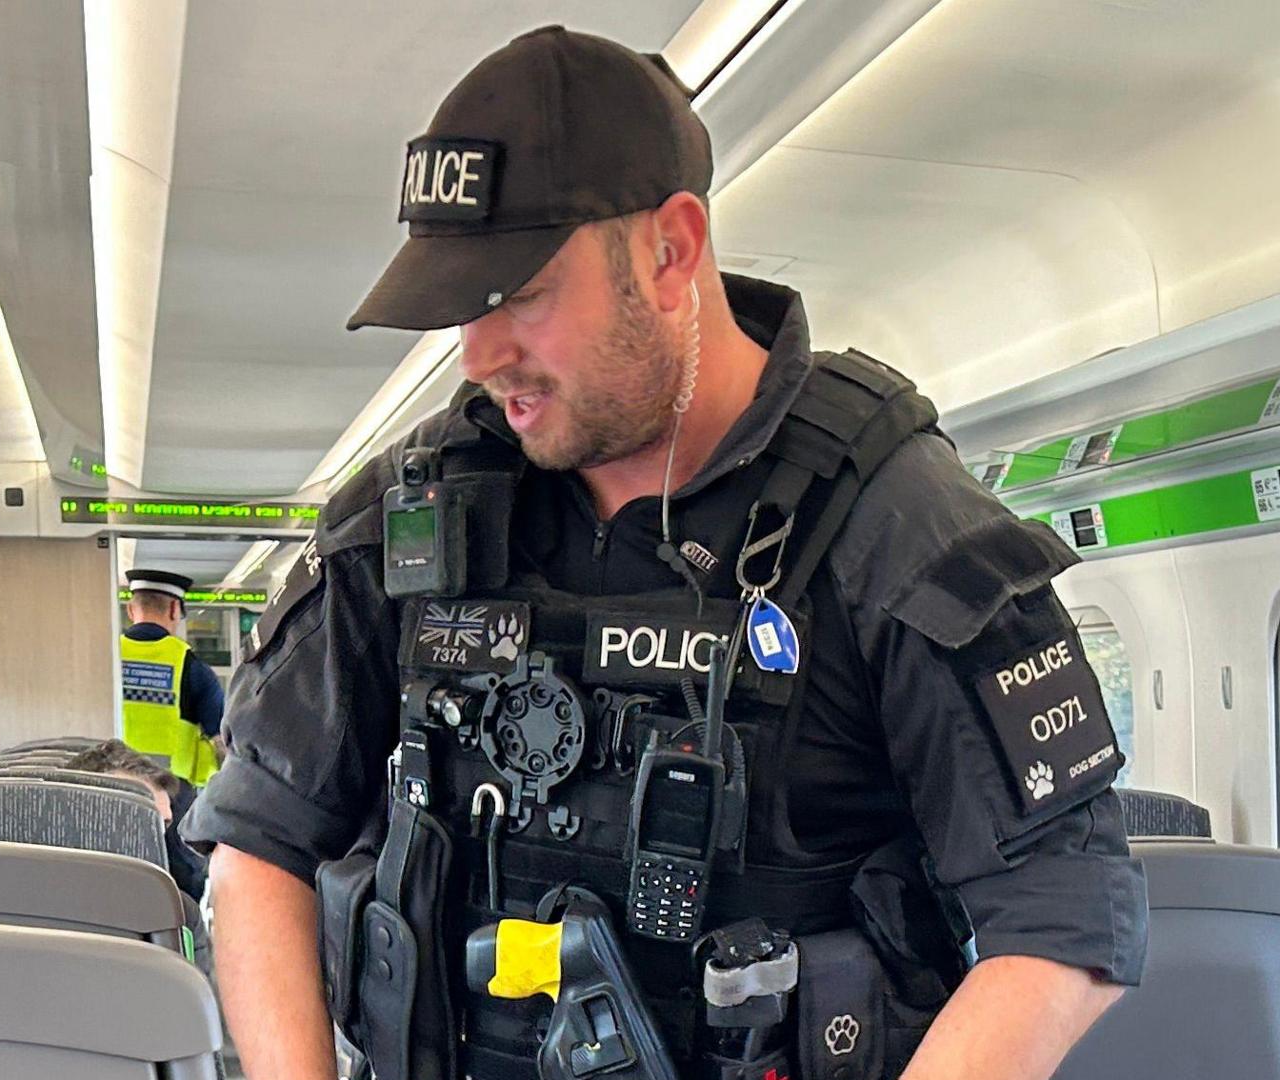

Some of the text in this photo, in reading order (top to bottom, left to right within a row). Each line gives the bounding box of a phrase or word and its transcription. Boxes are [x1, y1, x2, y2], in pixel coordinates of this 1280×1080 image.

[432, 647, 468, 665] 7374
[600, 626, 742, 674] POLIC
[996, 640, 1072, 695] POLICE
[1031, 696, 1087, 742] OD71
[1069, 744, 1114, 778] DOG SECTION
